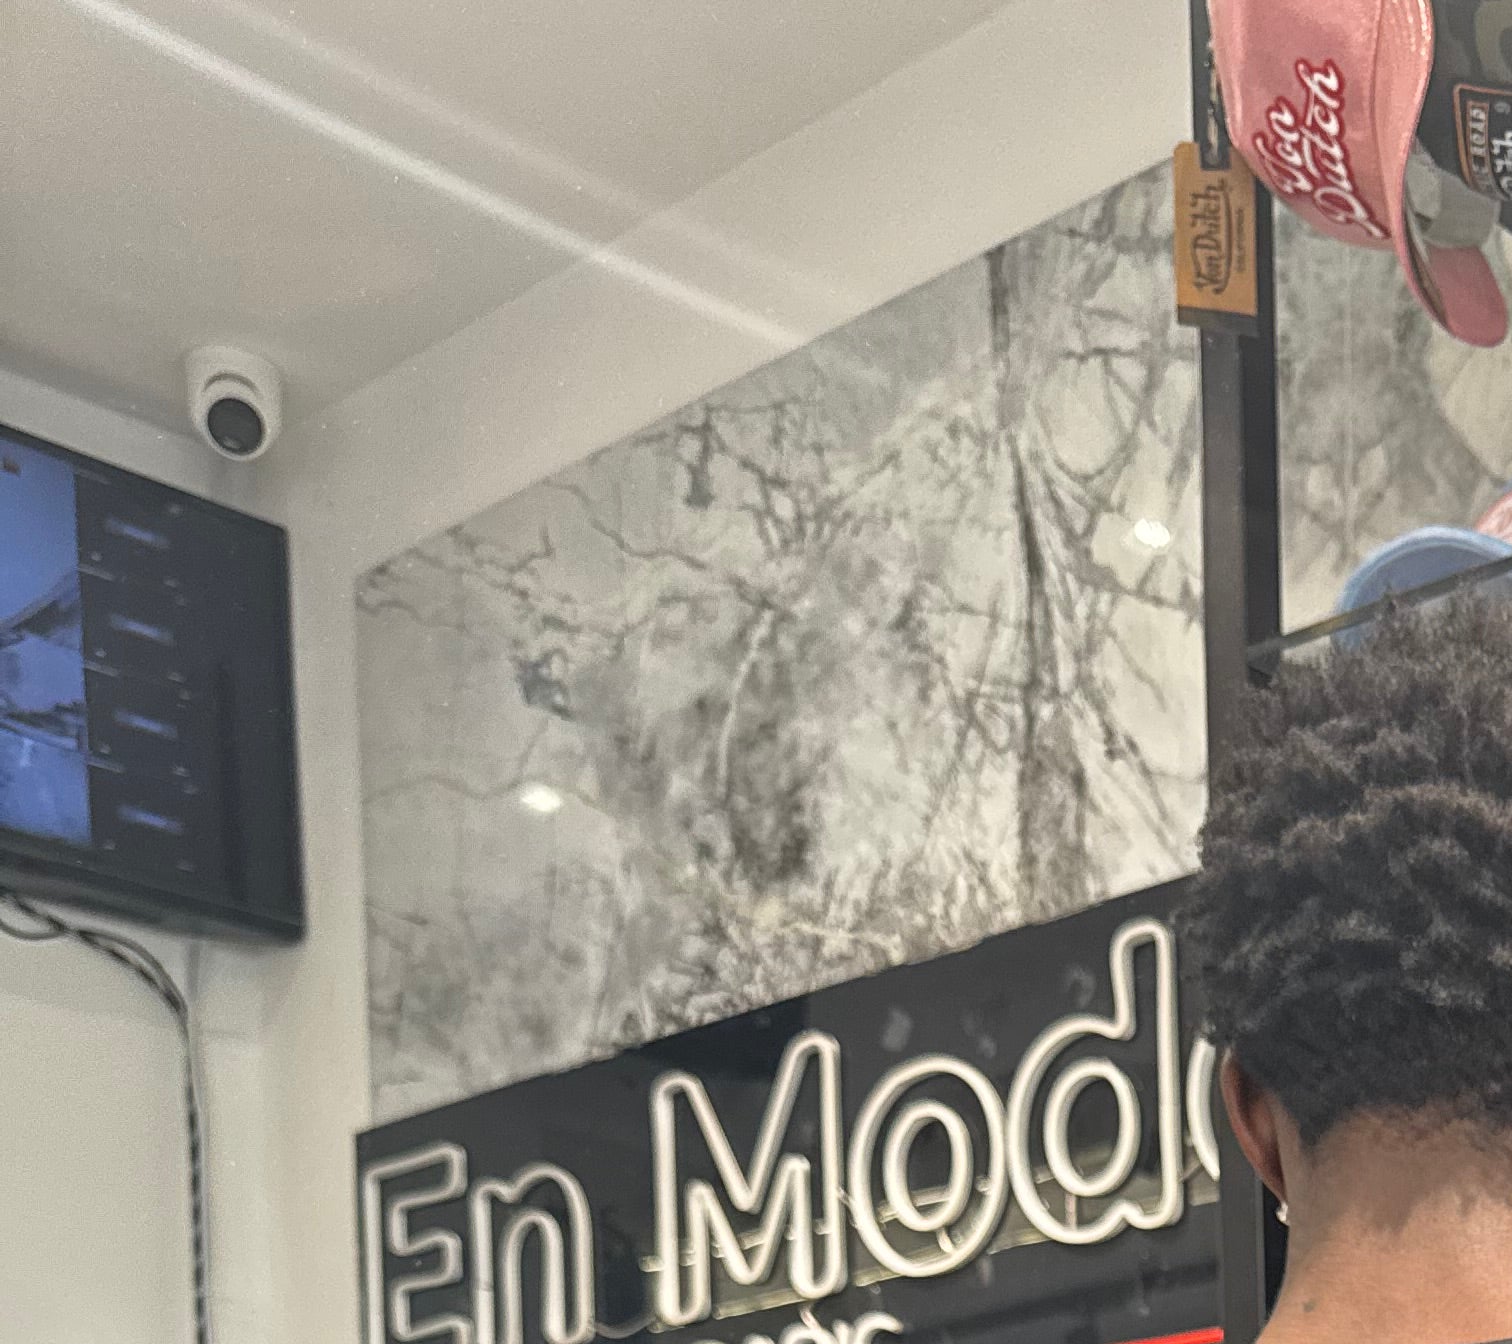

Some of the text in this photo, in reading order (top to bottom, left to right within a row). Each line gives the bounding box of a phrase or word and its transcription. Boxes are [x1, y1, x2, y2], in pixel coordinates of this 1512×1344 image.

[1252, 96, 1313, 195] Von
[1296, 59, 1390, 240] Dutch
[1189, 177, 1230, 253] Dutch
